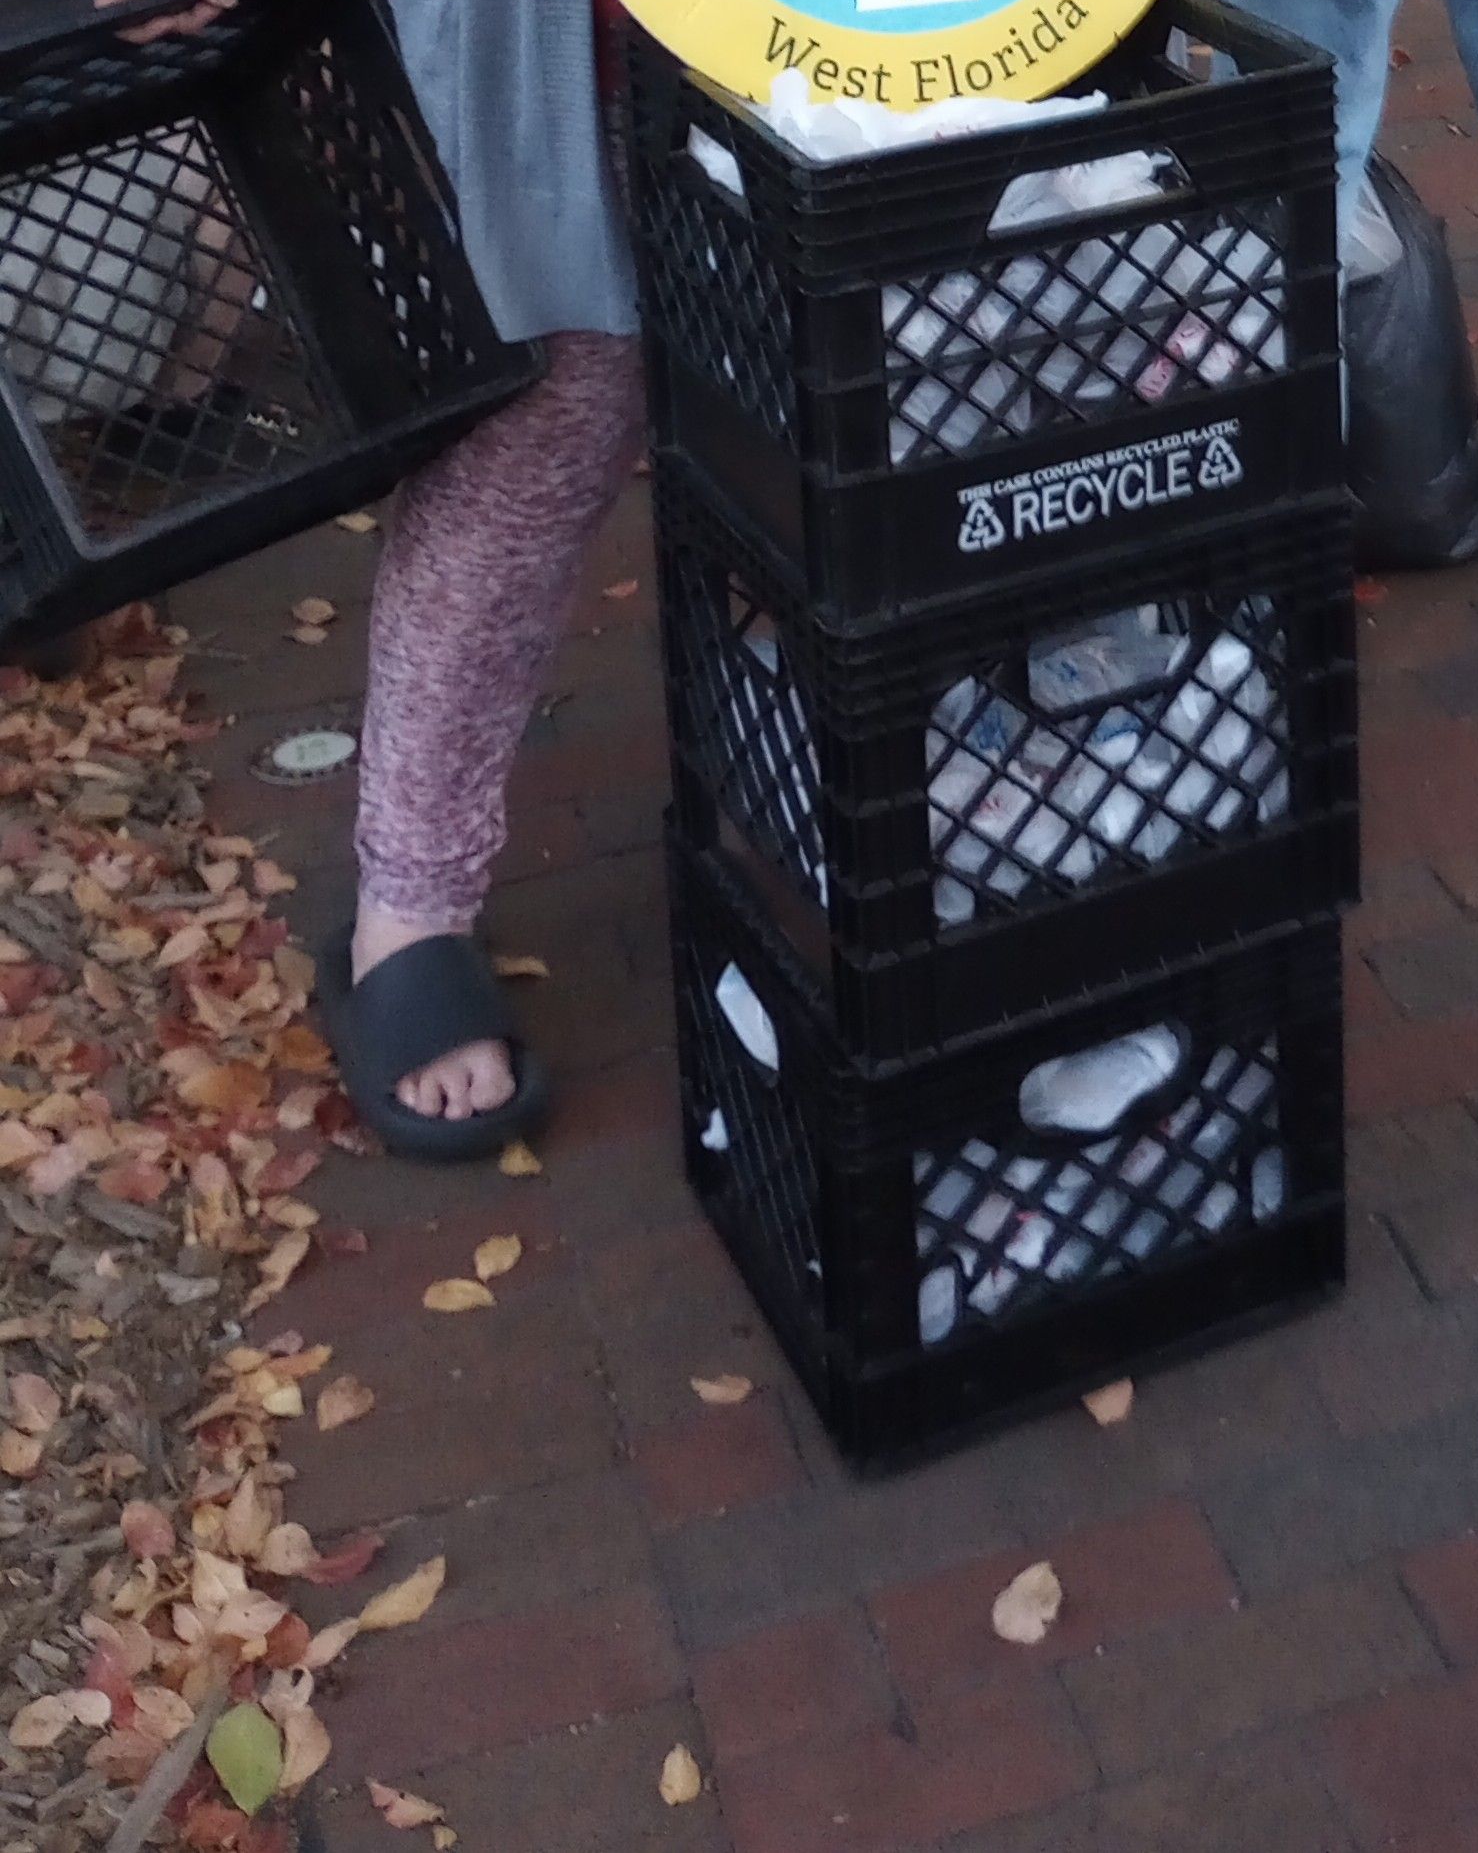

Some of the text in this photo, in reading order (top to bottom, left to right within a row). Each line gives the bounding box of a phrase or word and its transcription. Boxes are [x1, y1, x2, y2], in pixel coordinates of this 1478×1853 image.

[764, 16, 892, 104] West
[1012, 449, 1194, 540] RECYCLE
[1032, 453, 1105, 486] CONTAINS
[1105, 433, 1181, 465] RECYCLED
[1182, 417, 1240, 445] PLASTIC
